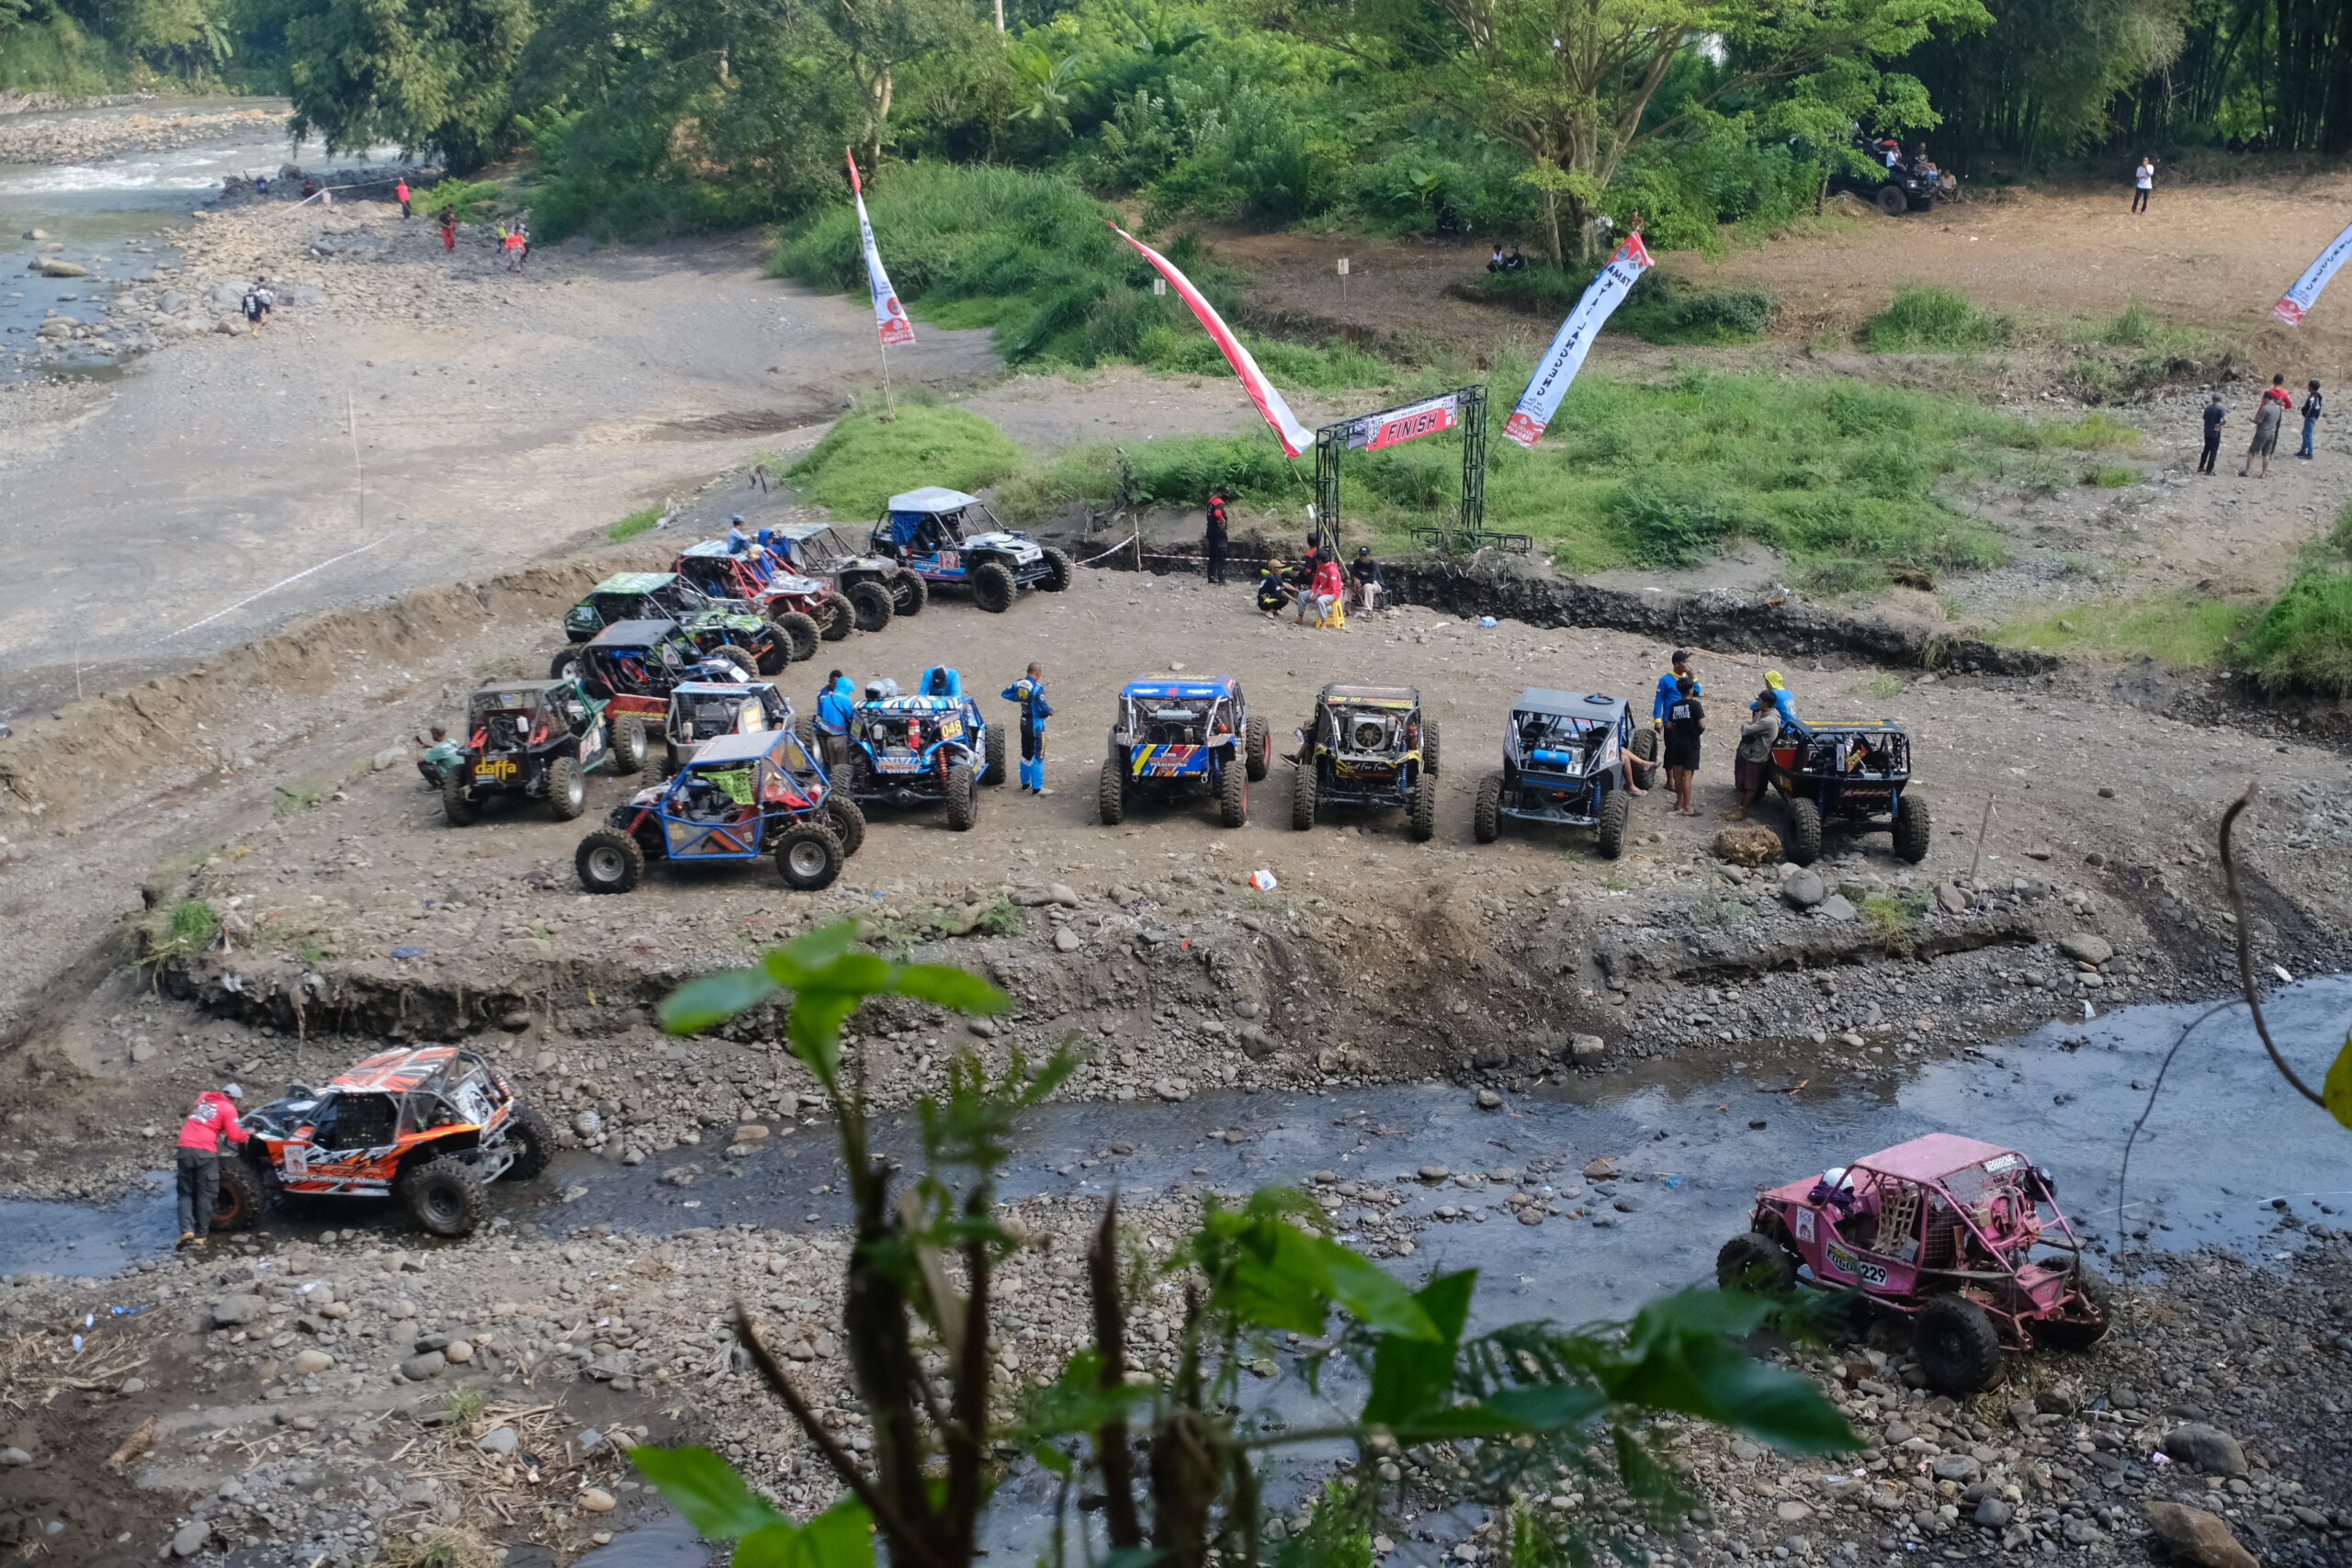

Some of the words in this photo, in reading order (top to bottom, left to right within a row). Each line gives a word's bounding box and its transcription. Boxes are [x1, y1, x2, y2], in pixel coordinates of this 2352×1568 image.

[1386, 411, 1439, 443] FINISH
[942, 719, 962, 738] 048
[475, 756, 516, 780] daffa
[1860, 1264, 1886, 1283] 229
